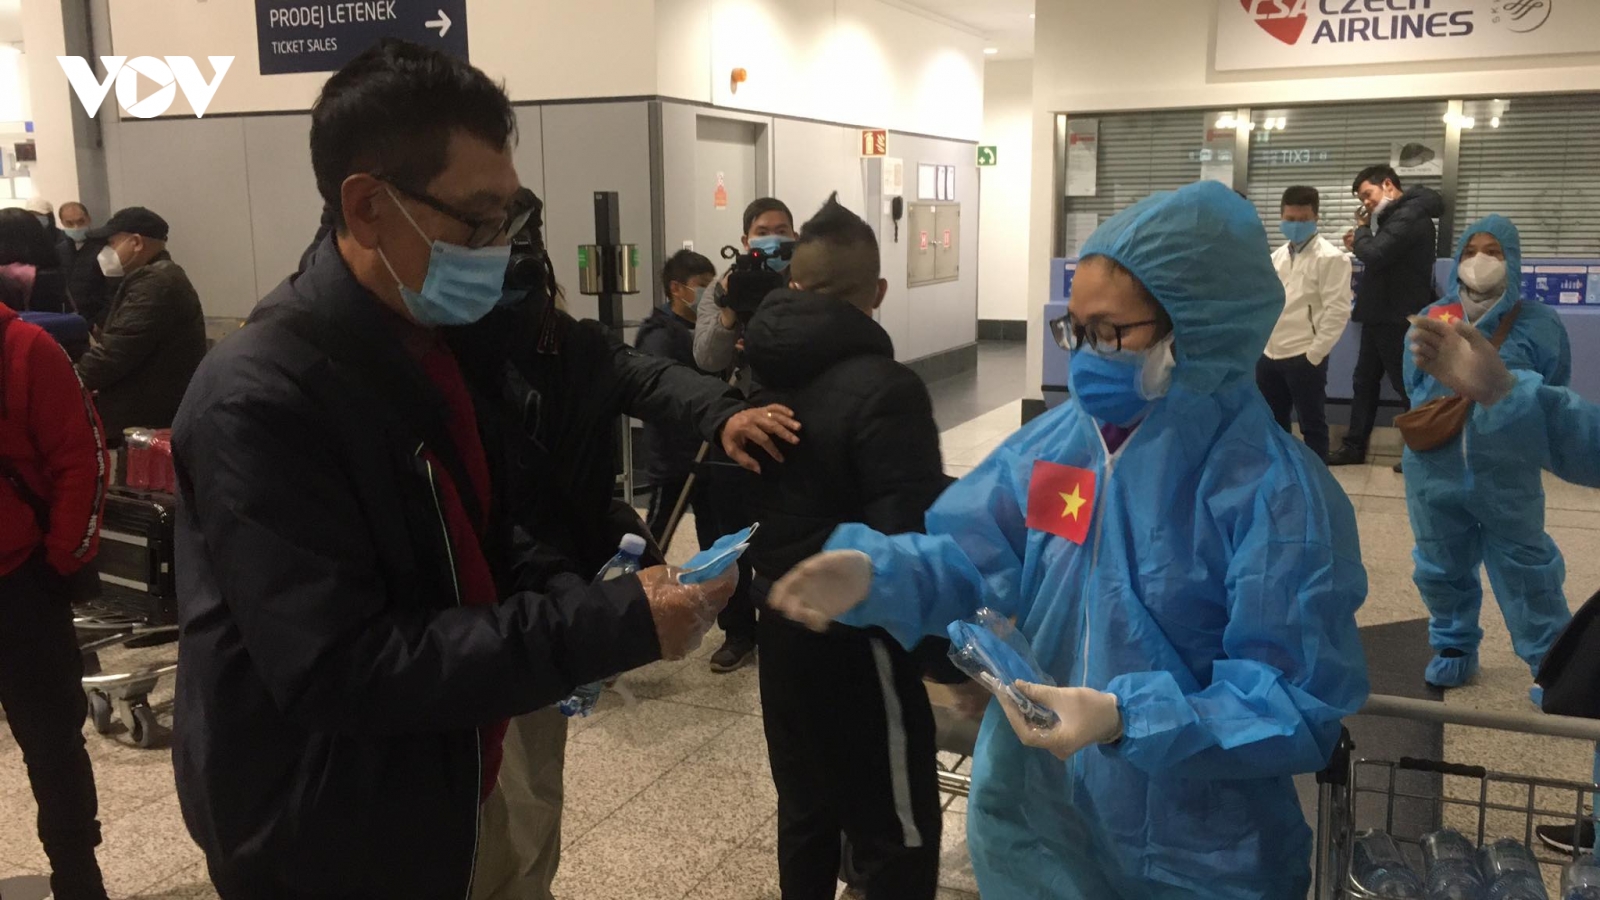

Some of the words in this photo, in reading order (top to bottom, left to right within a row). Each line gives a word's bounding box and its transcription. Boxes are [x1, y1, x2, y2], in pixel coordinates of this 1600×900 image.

[269, 5, 325, 29] PRODEJ
[327, 0, 397, 24] LETENEK
[1311, 10, 1474, 44] AIRLINES
[271, 39, 305, 54] TICKET
[306, 37, 338, 53] SALES
